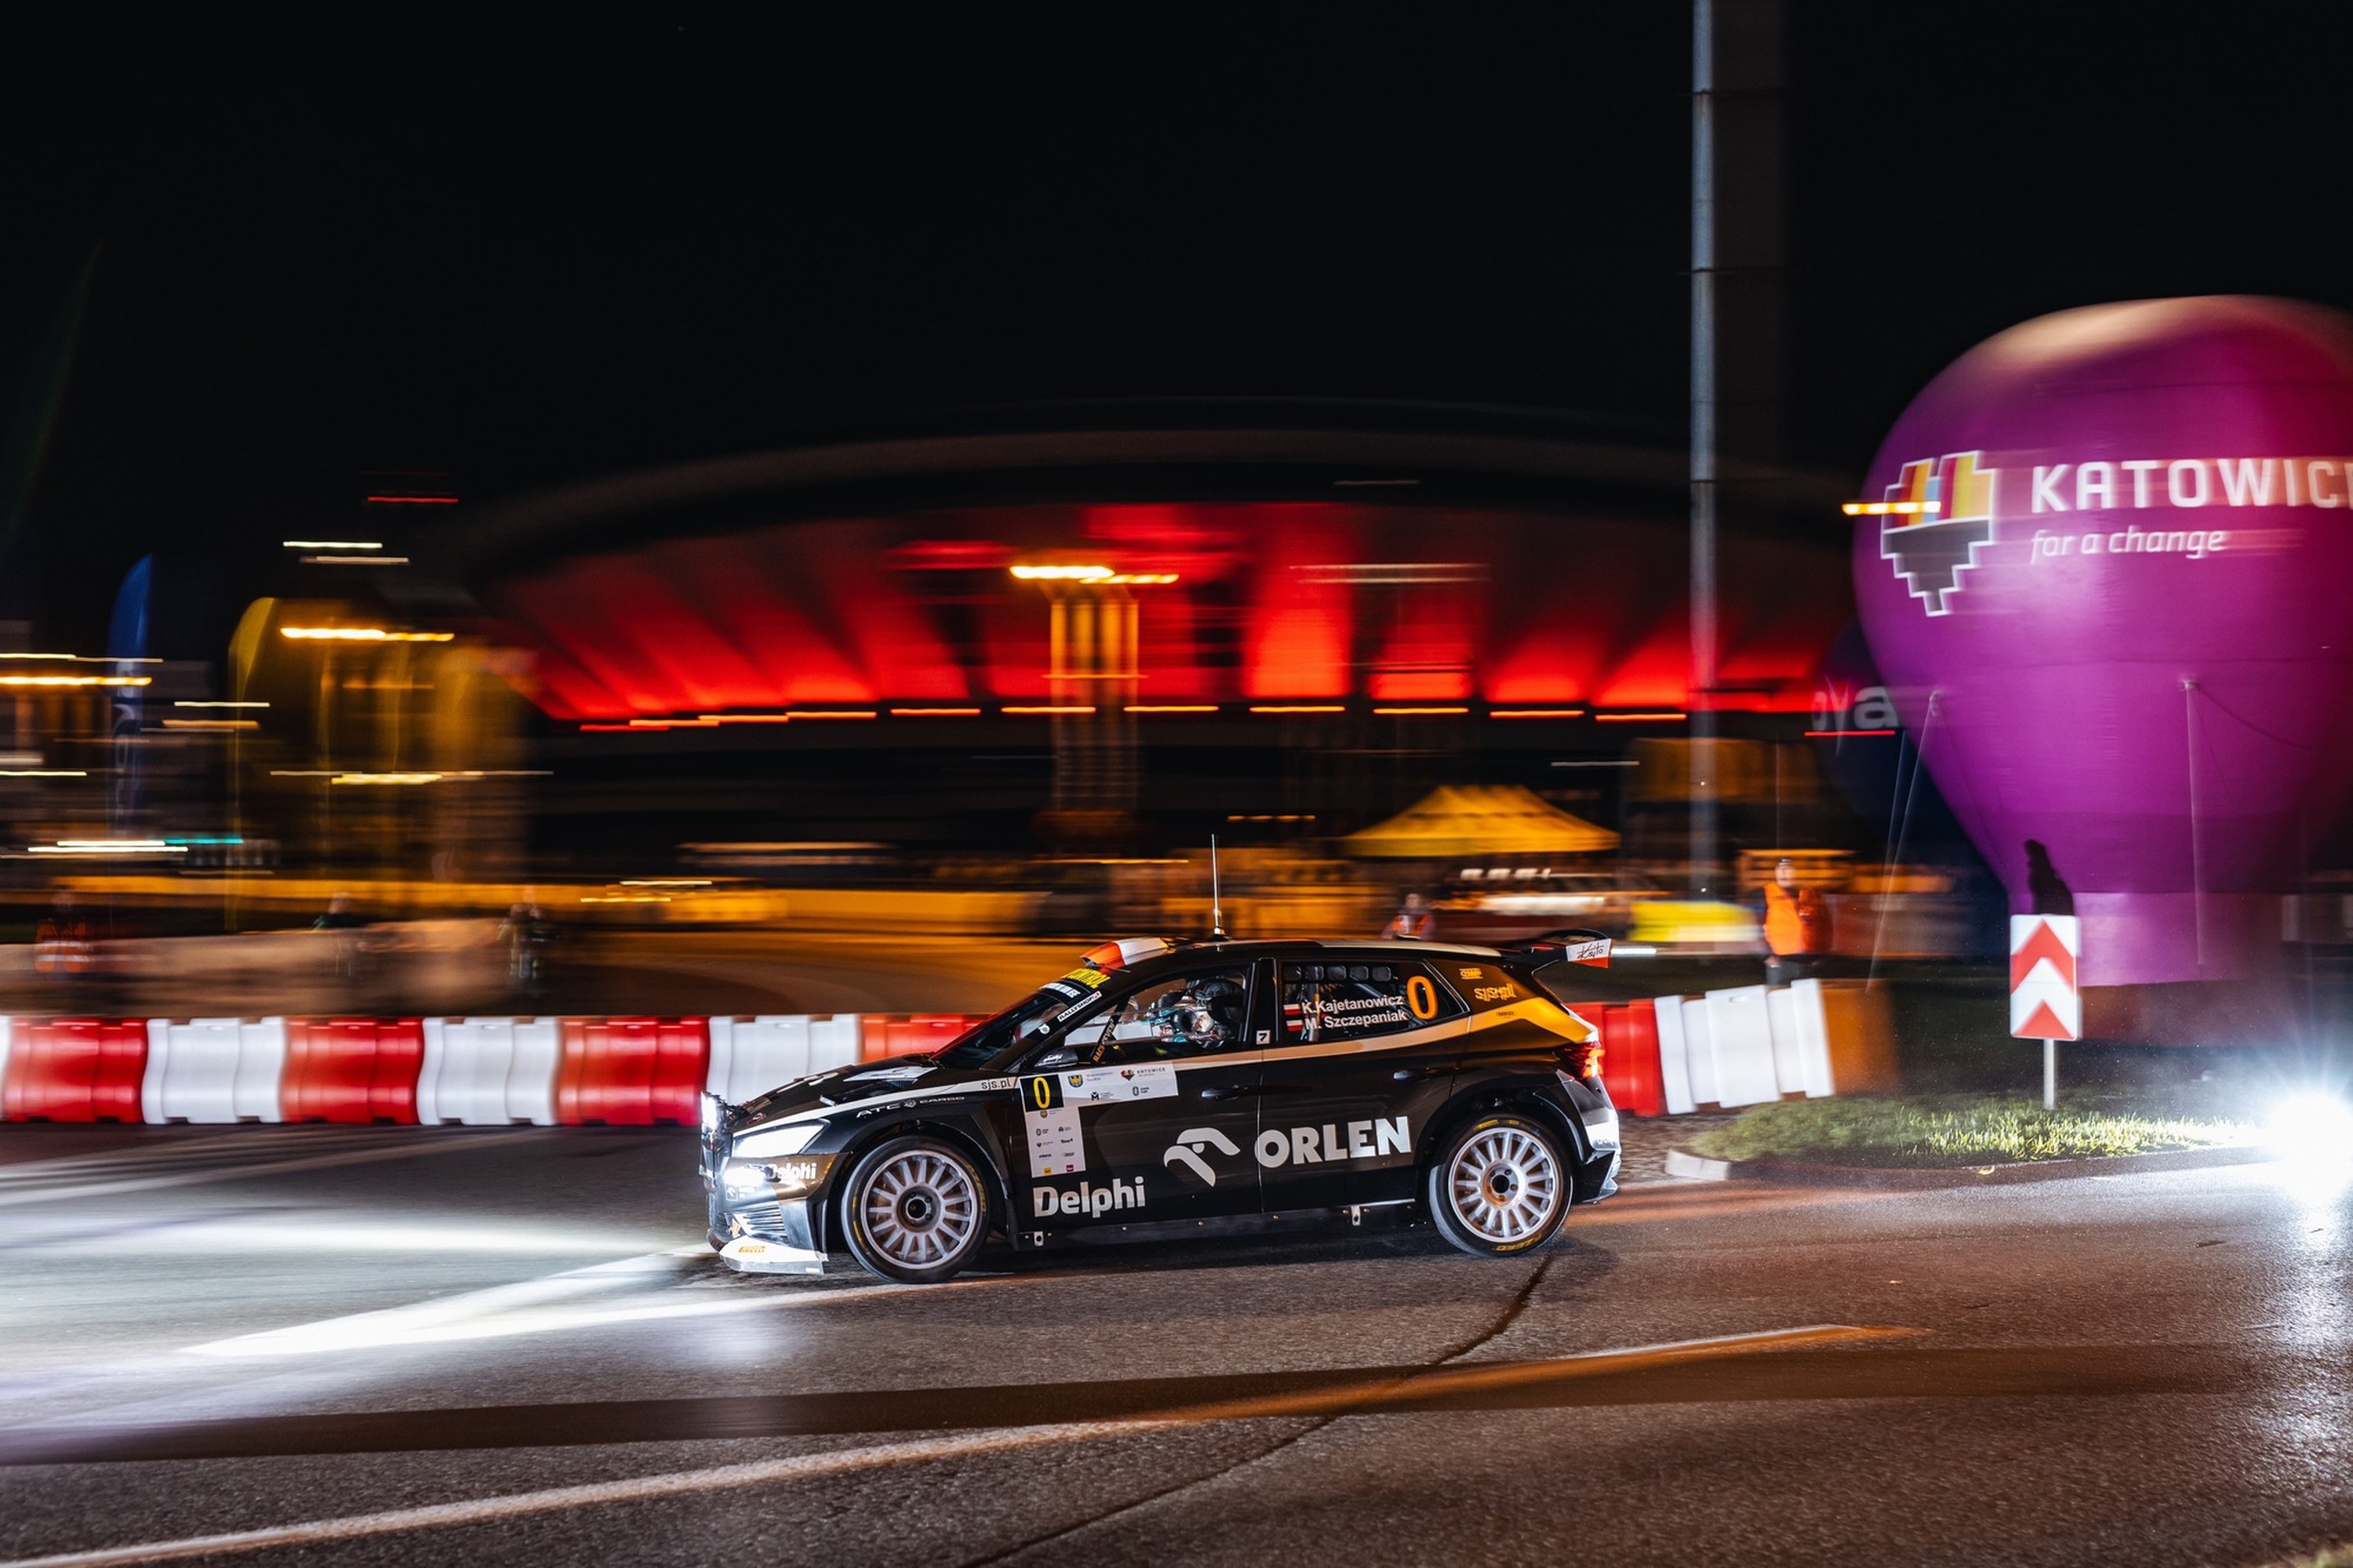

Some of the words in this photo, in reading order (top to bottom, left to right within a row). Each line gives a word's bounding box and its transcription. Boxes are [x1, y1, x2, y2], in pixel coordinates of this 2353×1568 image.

[2031, 529, 2075, 565] for
[2081, 533, 2102, 555] a
[2108, 525, 2228, 559] change
[1407, 976, 1438, 1019] 0
[1259, 1032, 1267, 1042] 7
[1305, 1018, 1322, 1030] M.
[1325, 1010, 1406, 1028] Szczepaniak
[981, 1078, 1012, 1091] sjs.pl
[1033, 1076, 1051, 1108] 0
[1254, 1115, 1411, 1168] ORLEN
[1033, 1176, 1146, 1218] Delphi
